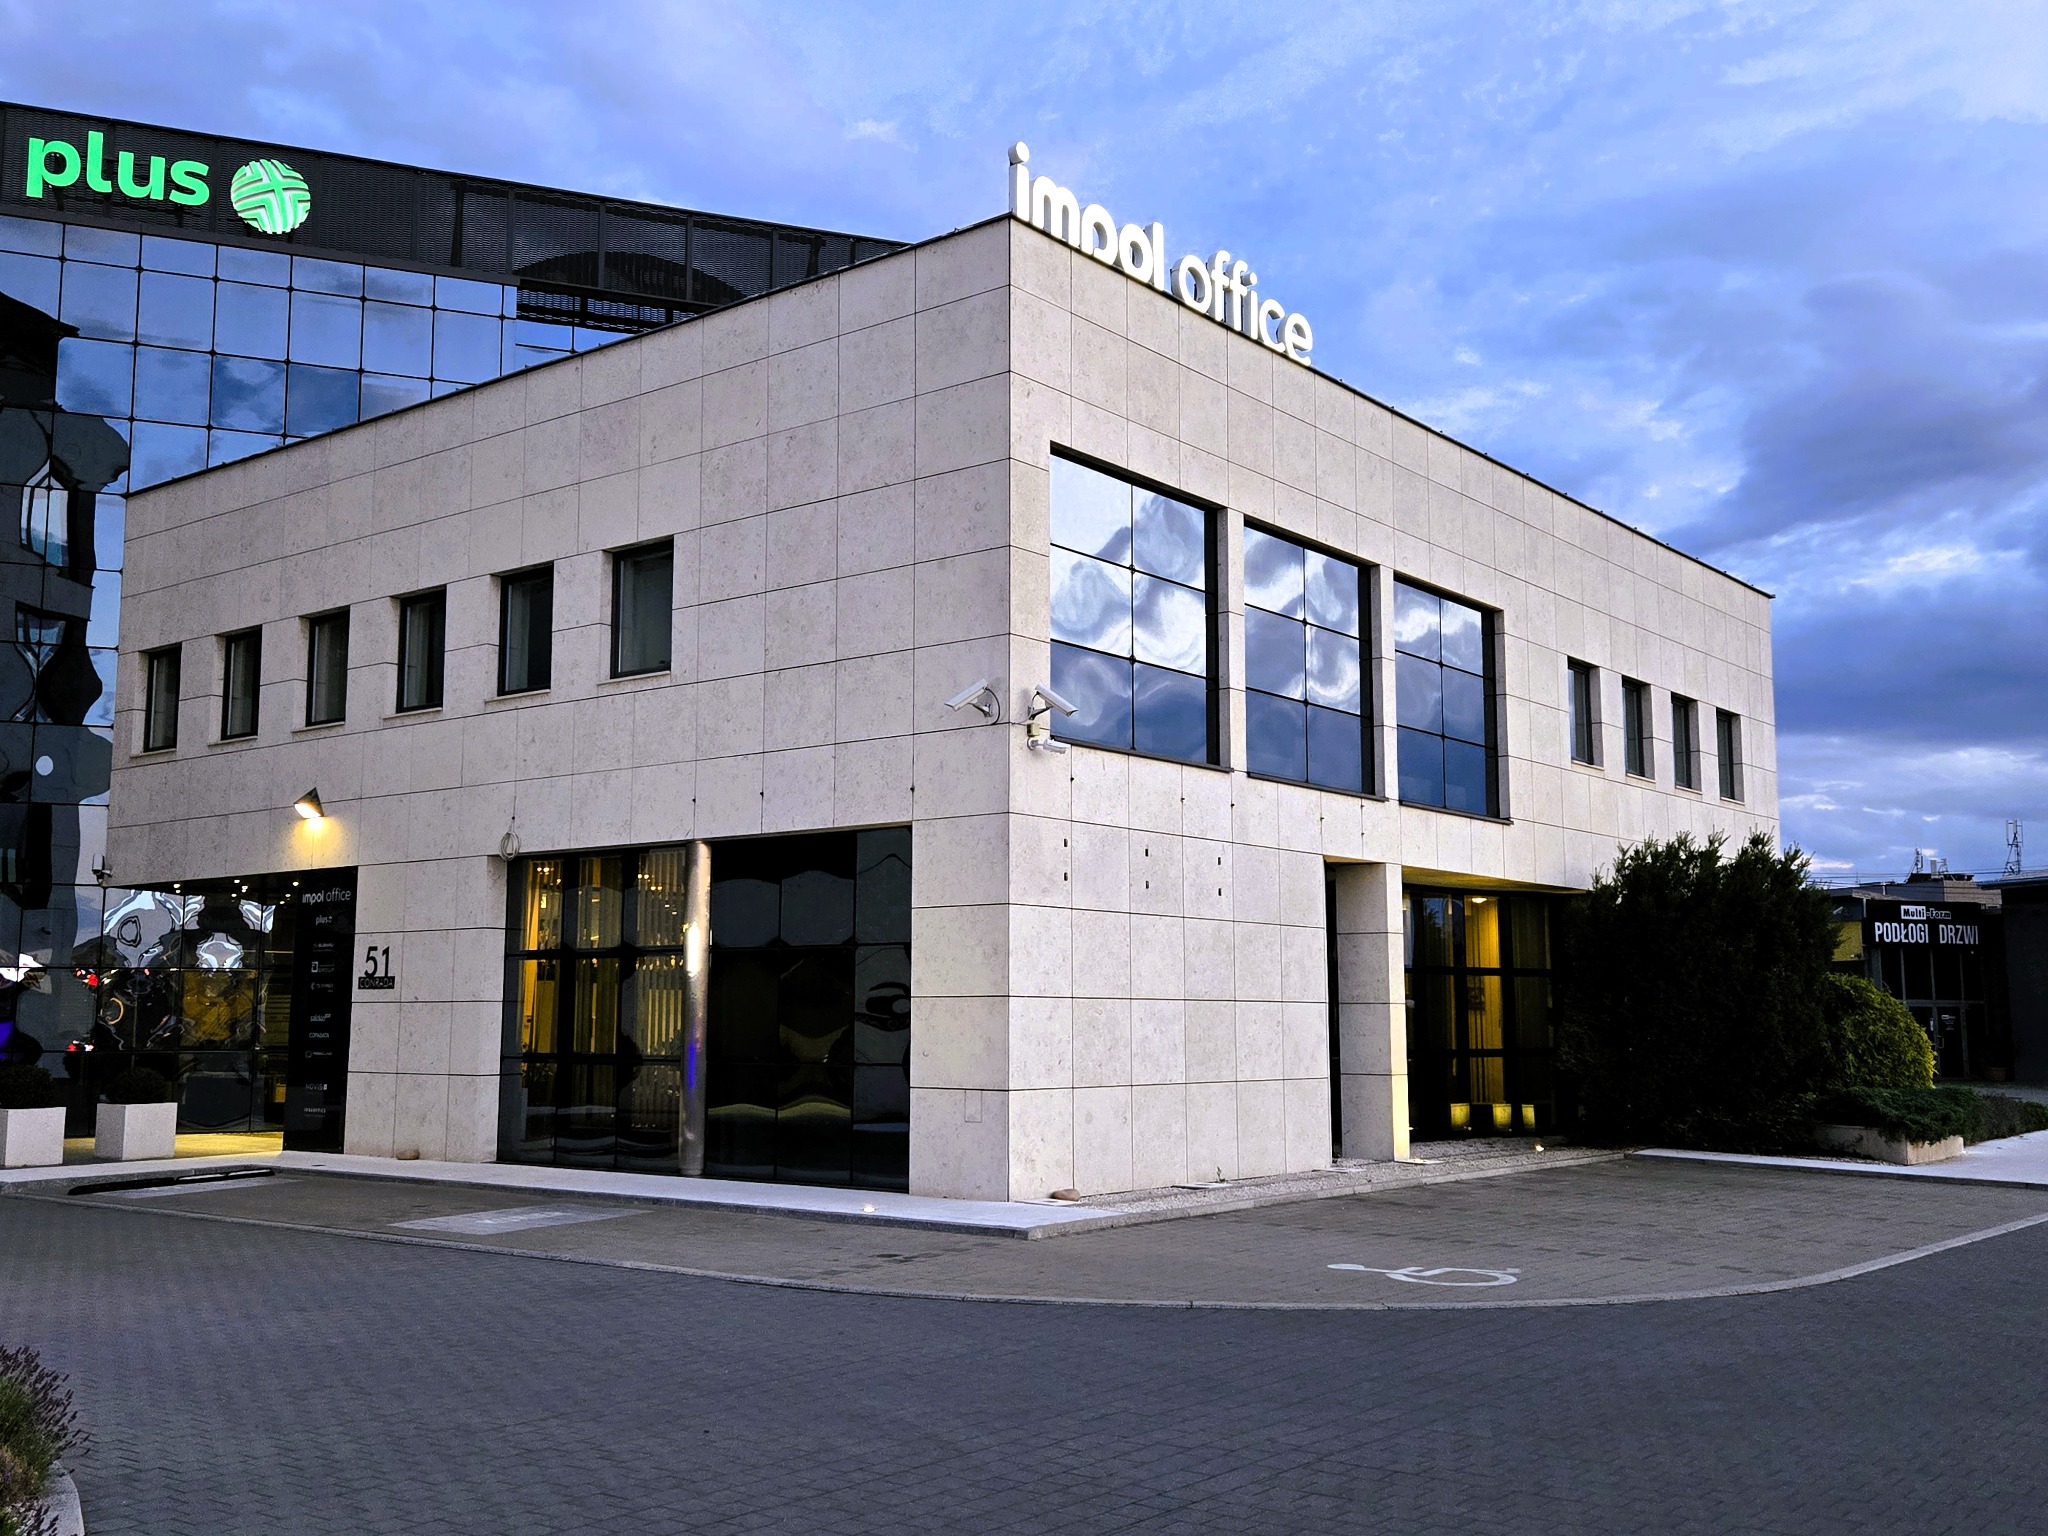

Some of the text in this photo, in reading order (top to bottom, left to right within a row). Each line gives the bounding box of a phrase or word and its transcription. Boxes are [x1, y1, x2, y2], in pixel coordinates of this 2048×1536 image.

[26, 130, 210, 206] plus
[1008, 141, 1313, 366] impol office
[302, 887, 352, 905] impol office
[1874, 922, 1979, 945] PODŁOGI DRZWI
[364, 946, 390, 978] 51
[359, 978, 394, 988] CONRADA
